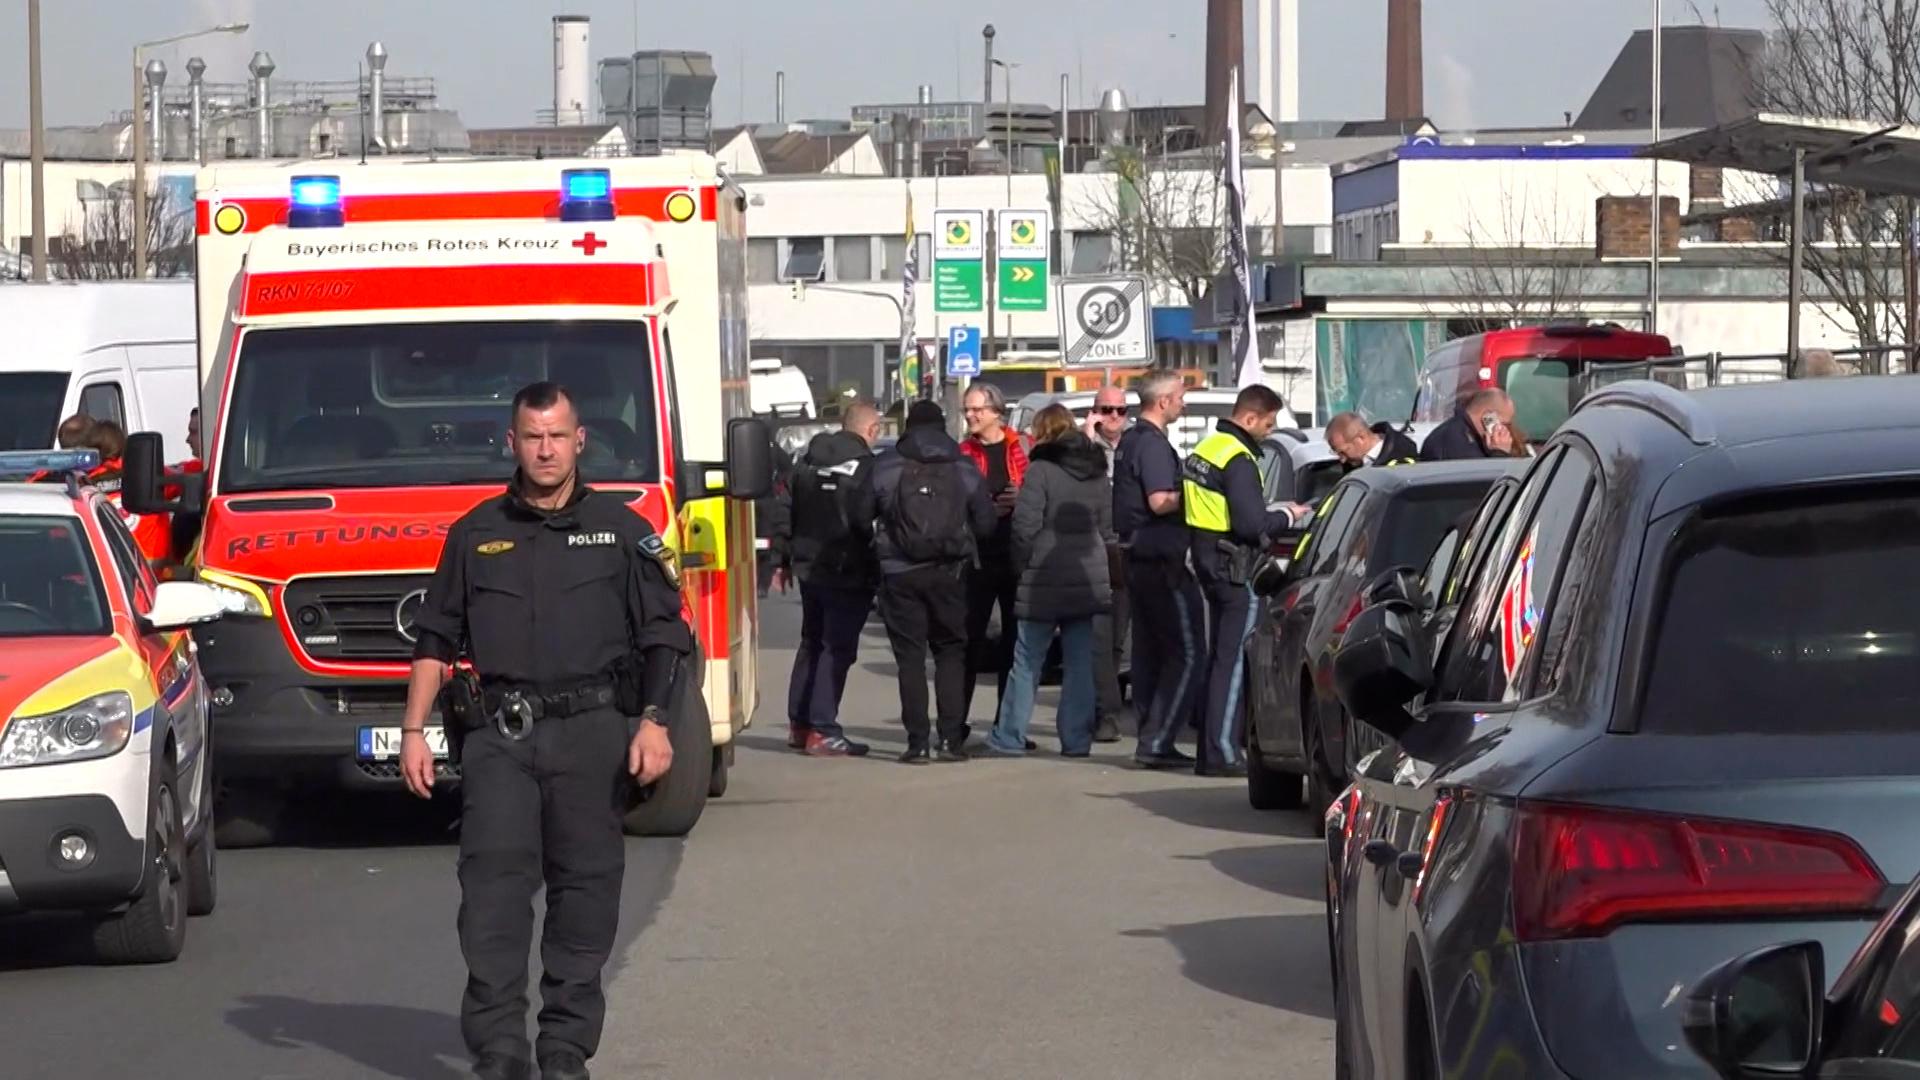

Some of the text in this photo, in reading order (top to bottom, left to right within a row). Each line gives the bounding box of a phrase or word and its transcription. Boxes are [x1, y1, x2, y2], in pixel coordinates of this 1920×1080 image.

[288, 237, 560, 257] Bayerisches Rotes Kreuz
[258, 285, 298, 302] RKN
[1088, 301, 1120, 326] 30
[954, 329, 968, 349] P
[1086, 342, 1125, 358] ZONE
[567, 533, 616, 546] POLIZEI
[375, 731, 389, 750] N
